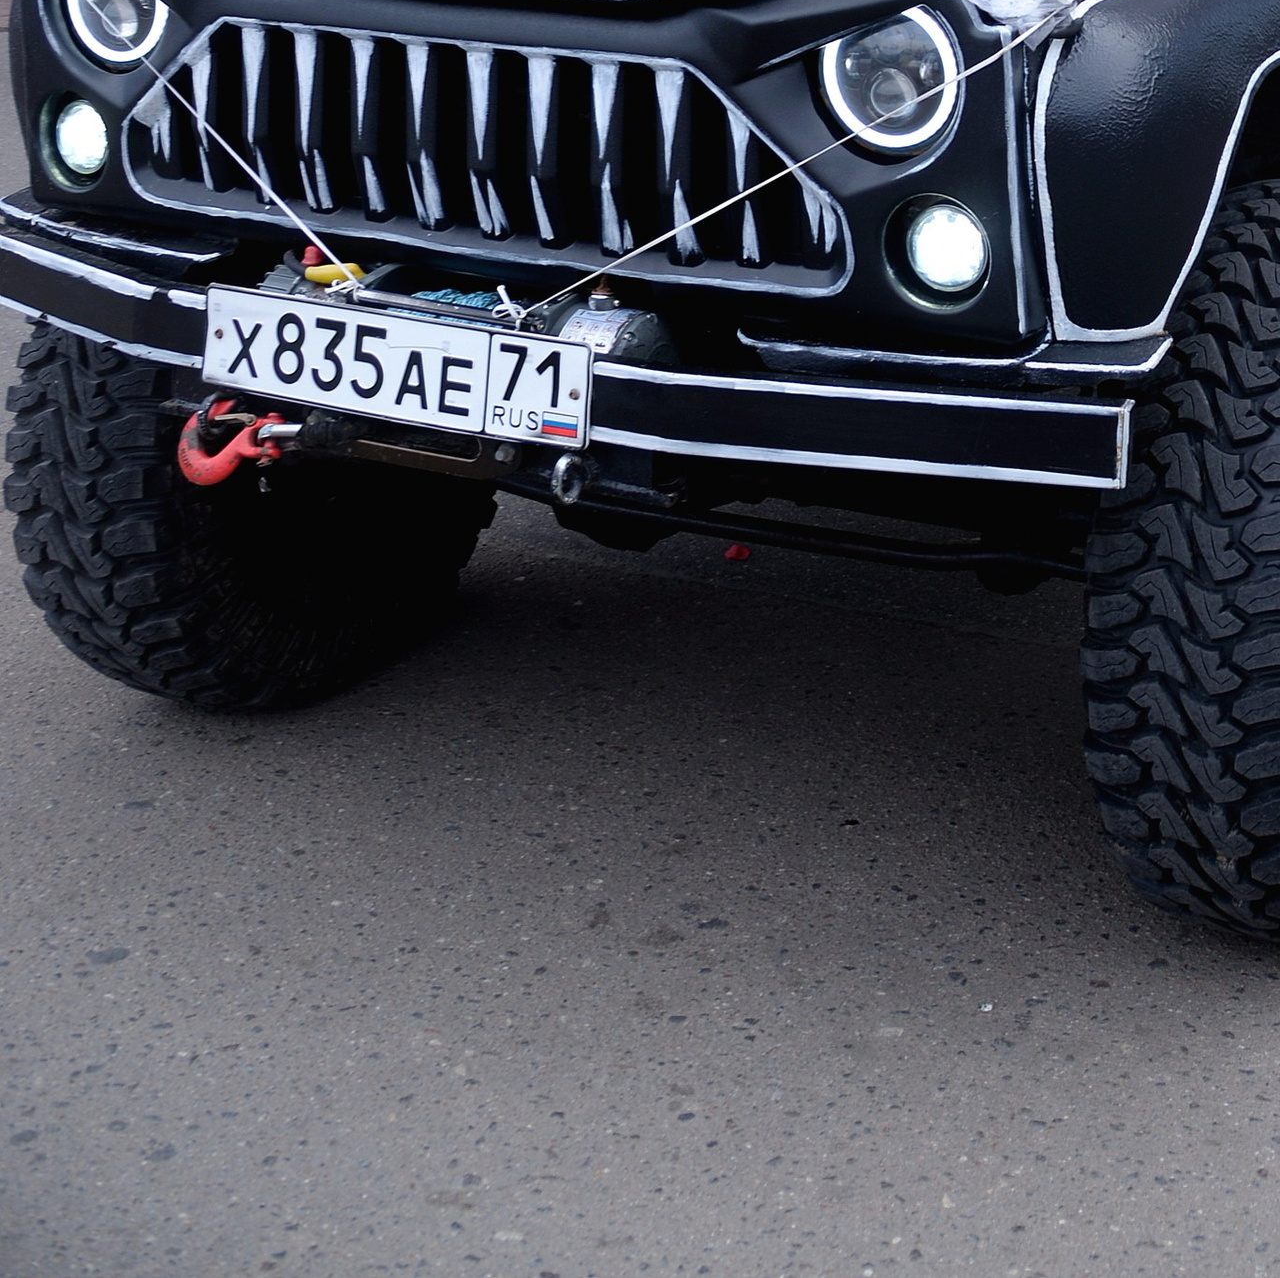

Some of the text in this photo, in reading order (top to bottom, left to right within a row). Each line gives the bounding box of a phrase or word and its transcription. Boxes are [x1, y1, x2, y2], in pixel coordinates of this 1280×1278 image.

[228, 312, 474, 417] Х835АЕ
[499, 343, 562, 408] 71
[491, 406, 539, 431] RUS
